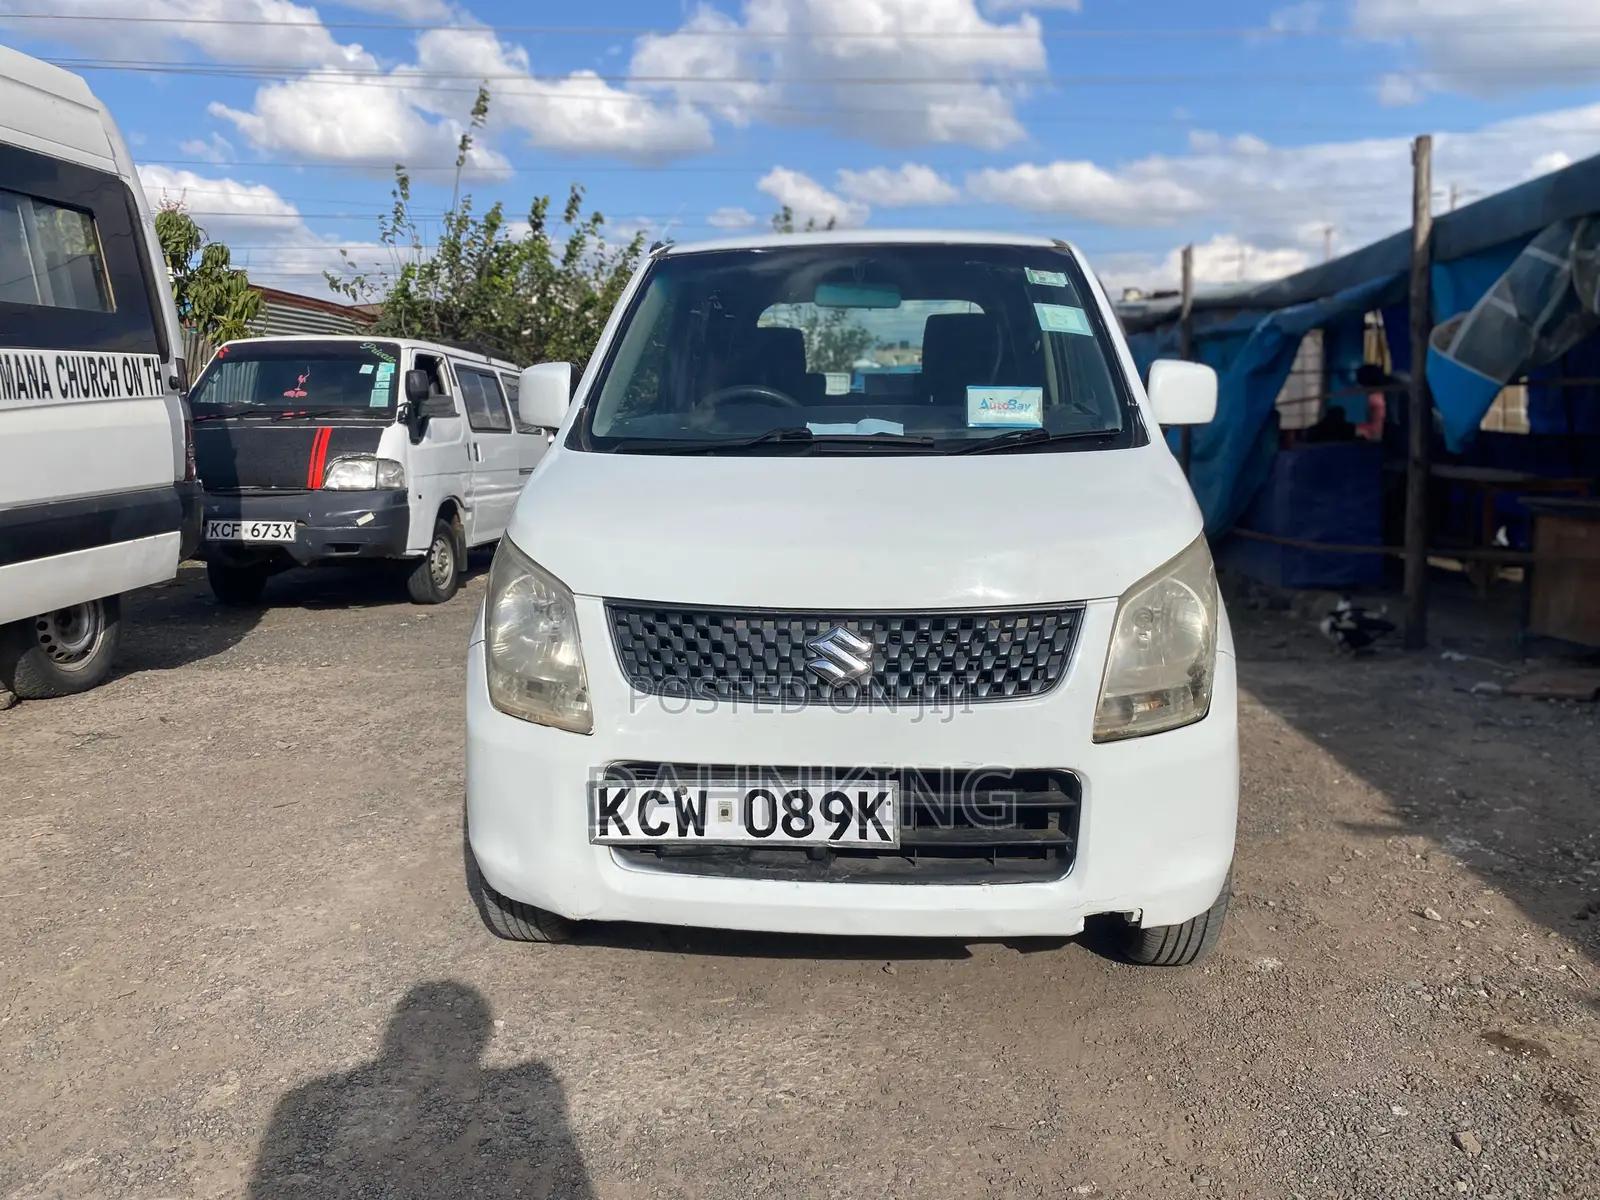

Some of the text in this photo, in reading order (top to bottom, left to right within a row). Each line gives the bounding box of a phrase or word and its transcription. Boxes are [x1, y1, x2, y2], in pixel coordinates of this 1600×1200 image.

[56, 355, 120, 398] CHURCH
[122, 357, 144, 396] ON
[144, 357, 164, 396] TH
[979, 398, 1032, 411] AutoBay
[209, 522, 292, 538] KCF 673X
[598, 787, 707, 838] KCW
[743, 788, 892, 842] 089K
